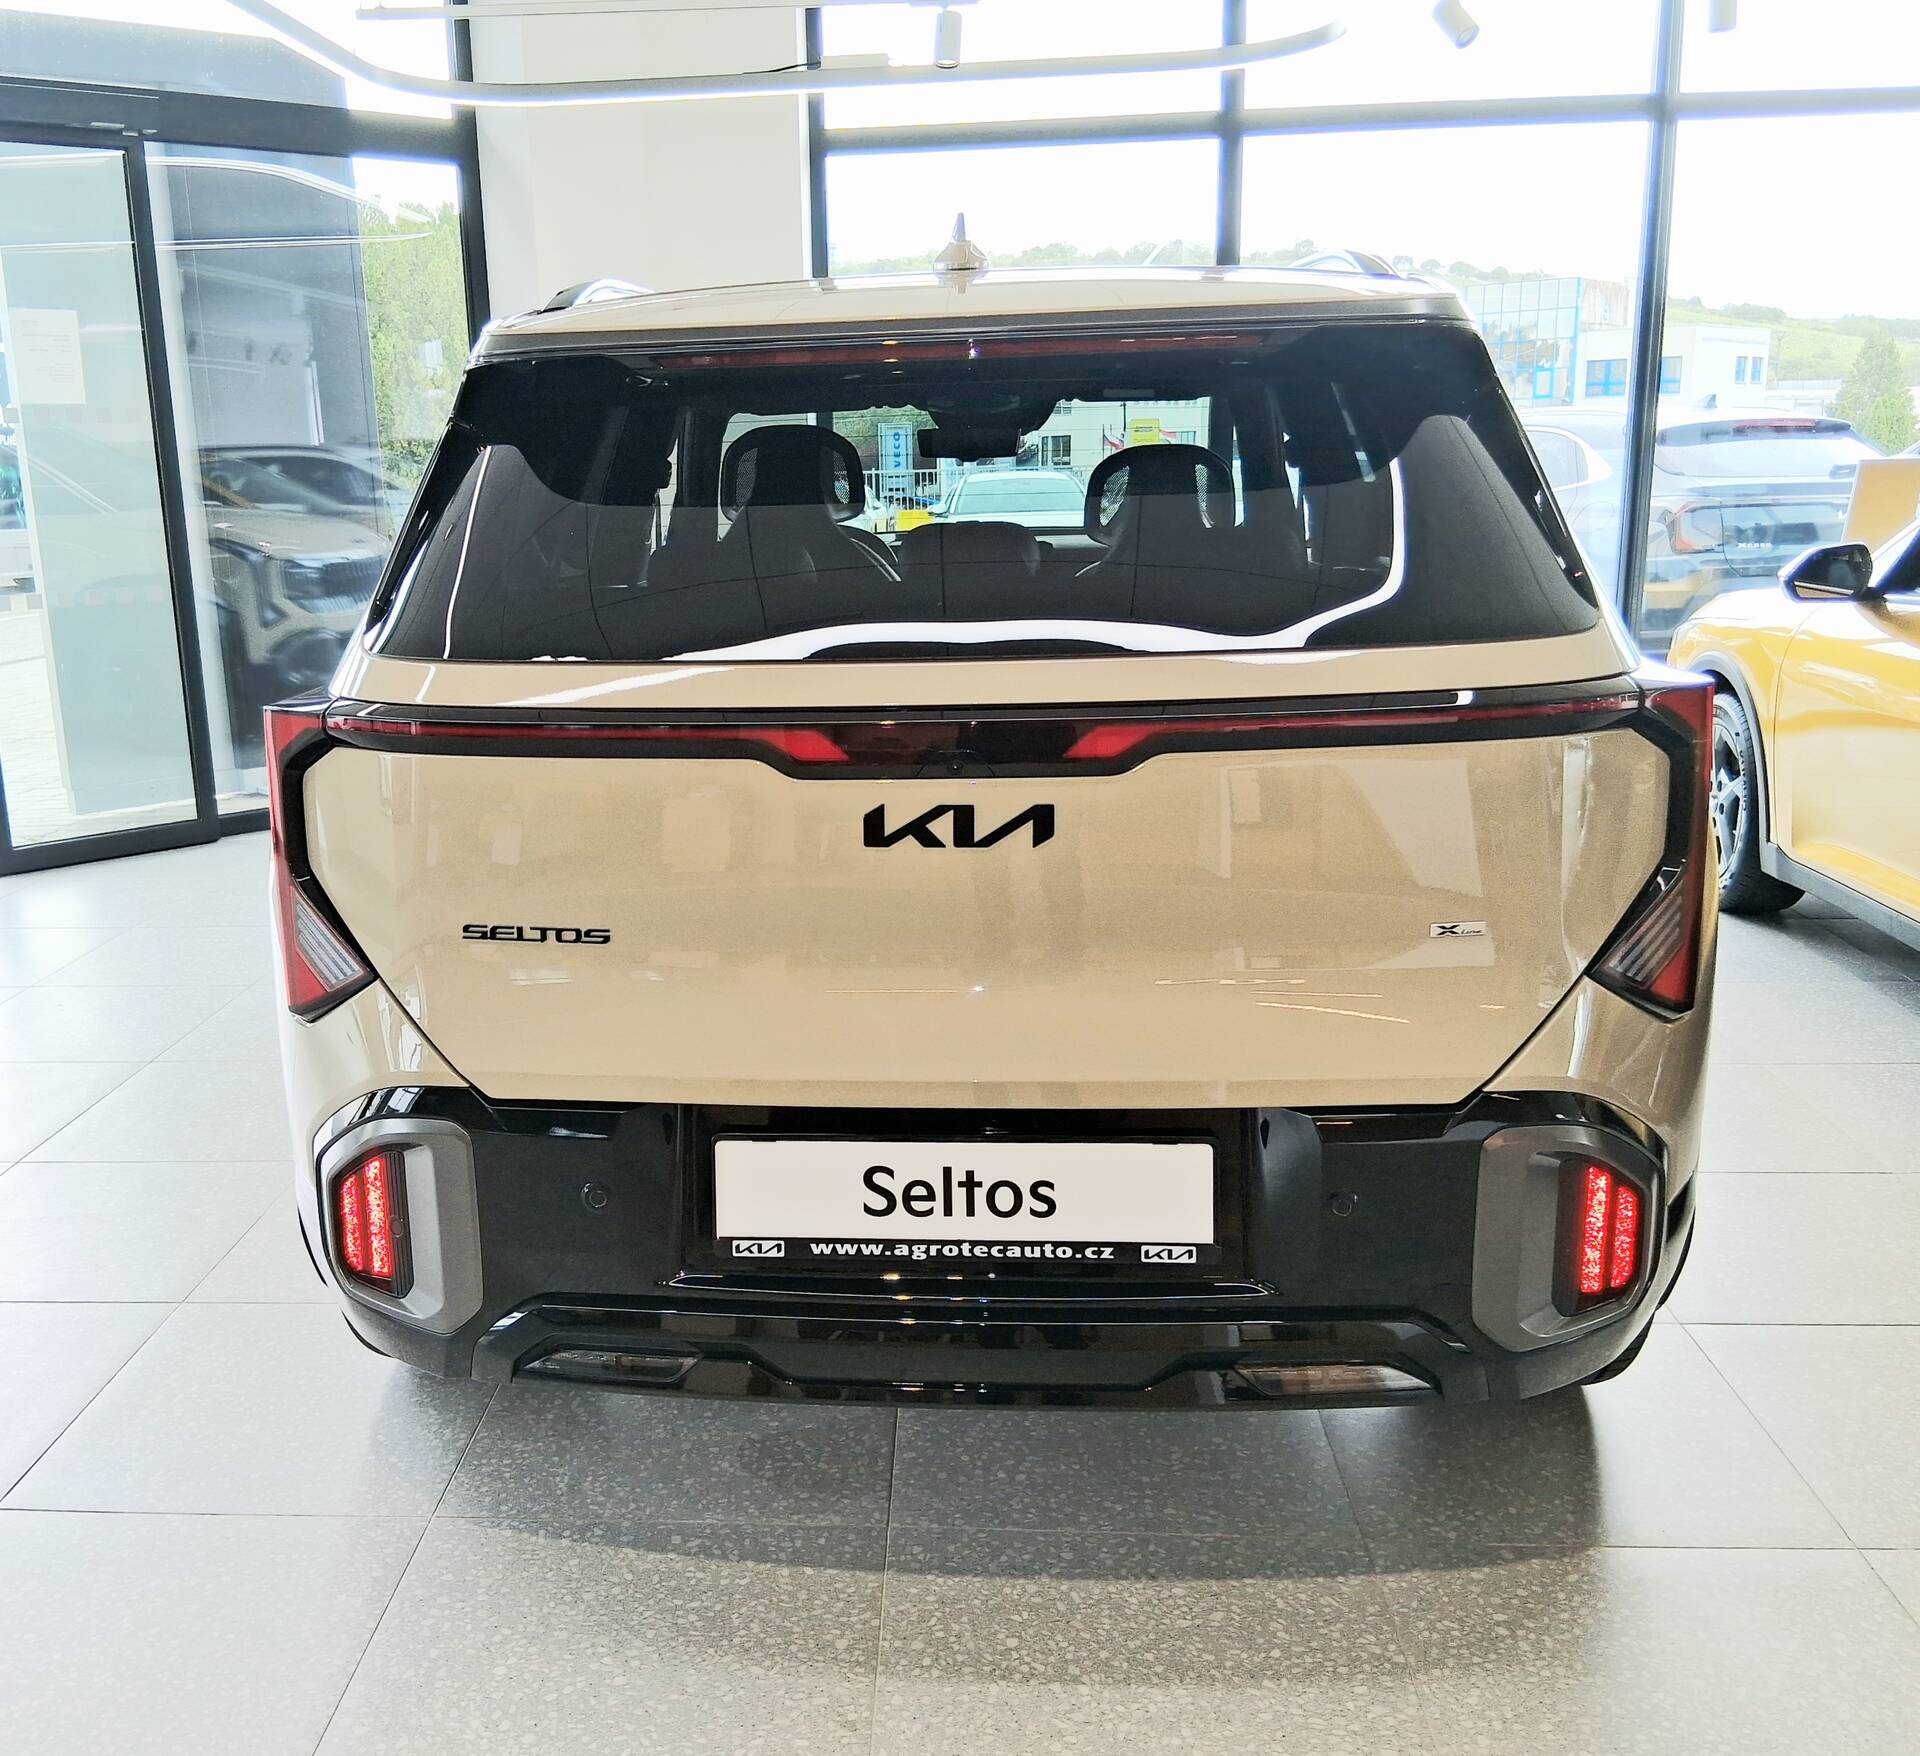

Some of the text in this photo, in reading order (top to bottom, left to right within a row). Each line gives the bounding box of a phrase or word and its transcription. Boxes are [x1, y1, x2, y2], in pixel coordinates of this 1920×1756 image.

[893, 432, 901, 471] VECO
[863, 803, 1055, 848] KIA
[462, 924, 611, 944] SELTOS
[862, 1165, 1057, 1218] Seltos
[734, 1242, 1195, 1261] KIA www.agrotecauto.cz KIA
